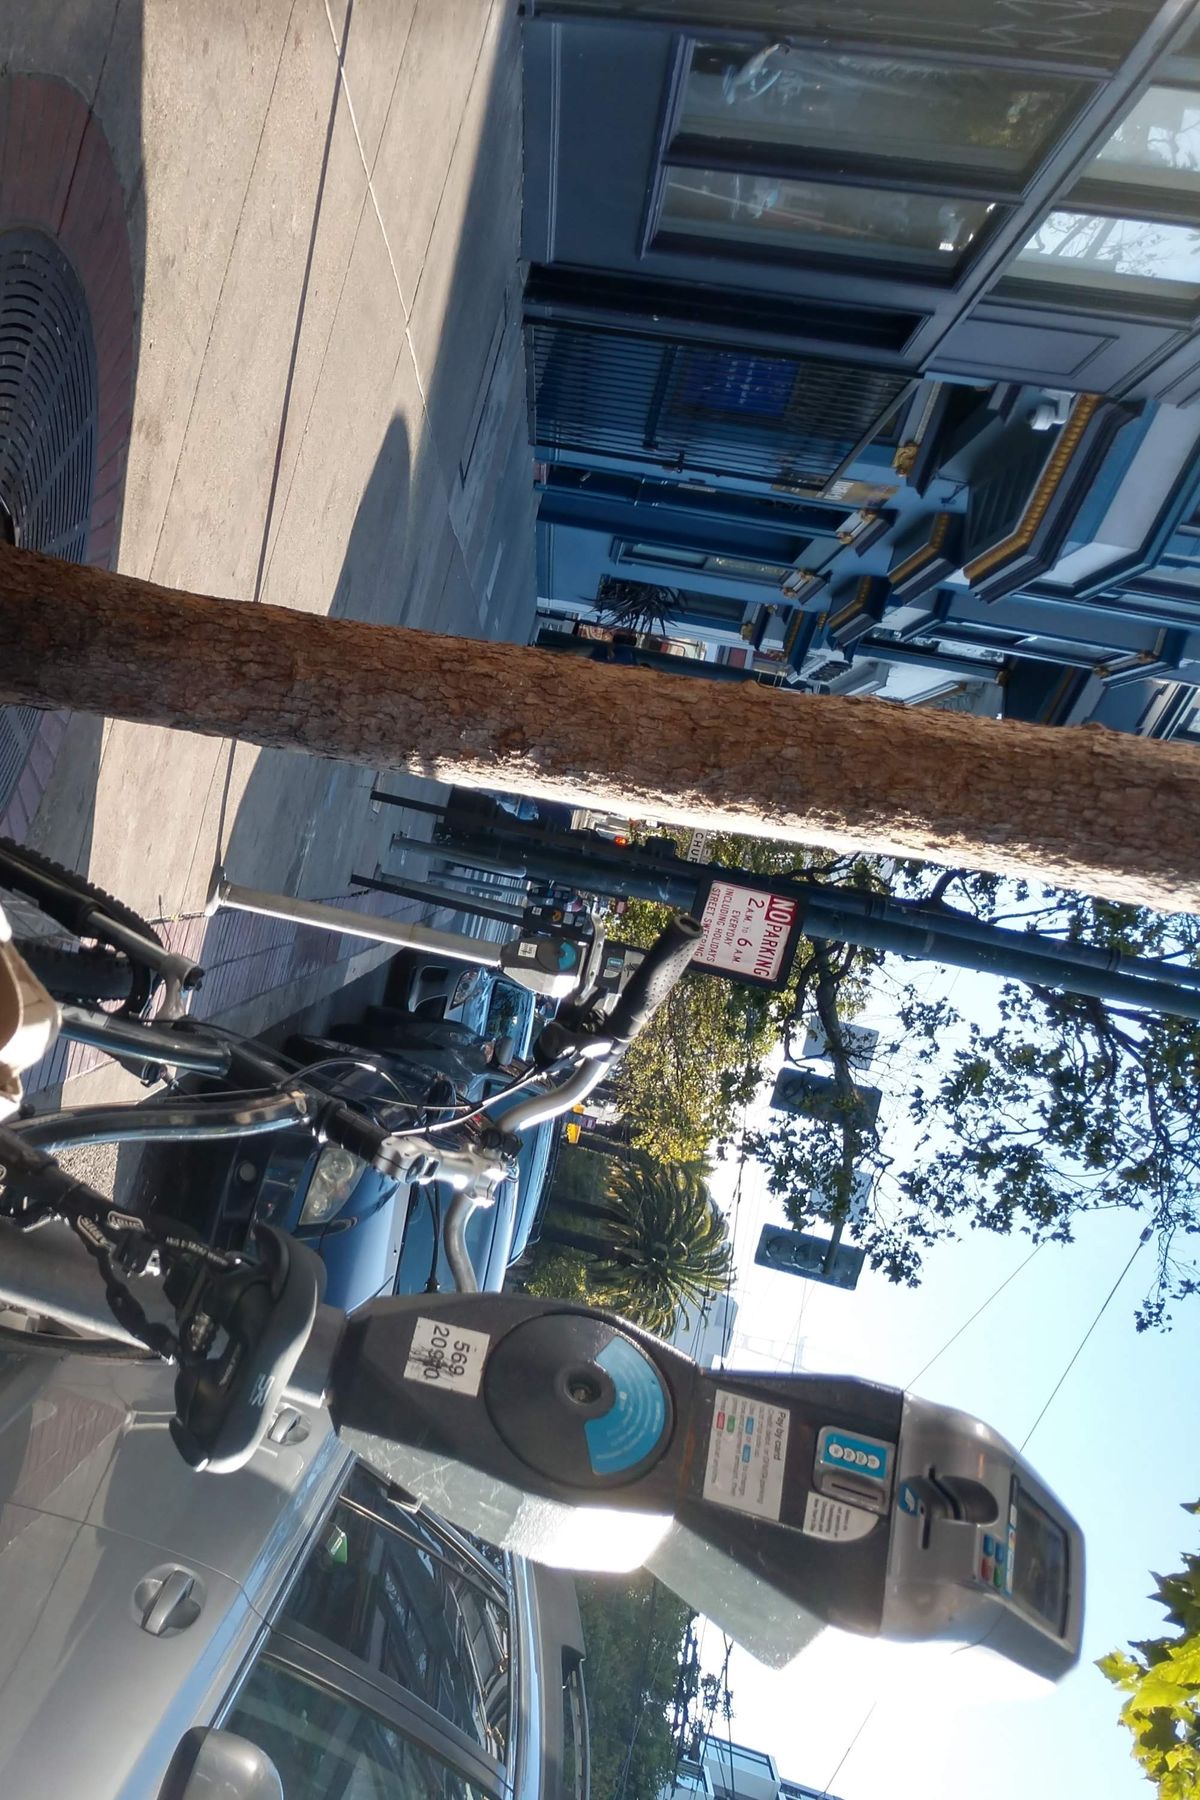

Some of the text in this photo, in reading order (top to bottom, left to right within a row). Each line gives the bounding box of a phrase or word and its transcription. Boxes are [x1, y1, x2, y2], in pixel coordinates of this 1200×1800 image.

[706, 887, 721, 916] STREET
[748, 897, 765, 909] 2
[706, 887, 734, 963] INCLUDING HOLIDAYS
[724, 910, 740, 947] EVERYDAY
[753, 898, 795, 977] NO PARKING
[737, 937, 752, 947] 6
[448, 1340, 471, 1377] 569
[773, 1440, 782, 1461] card
